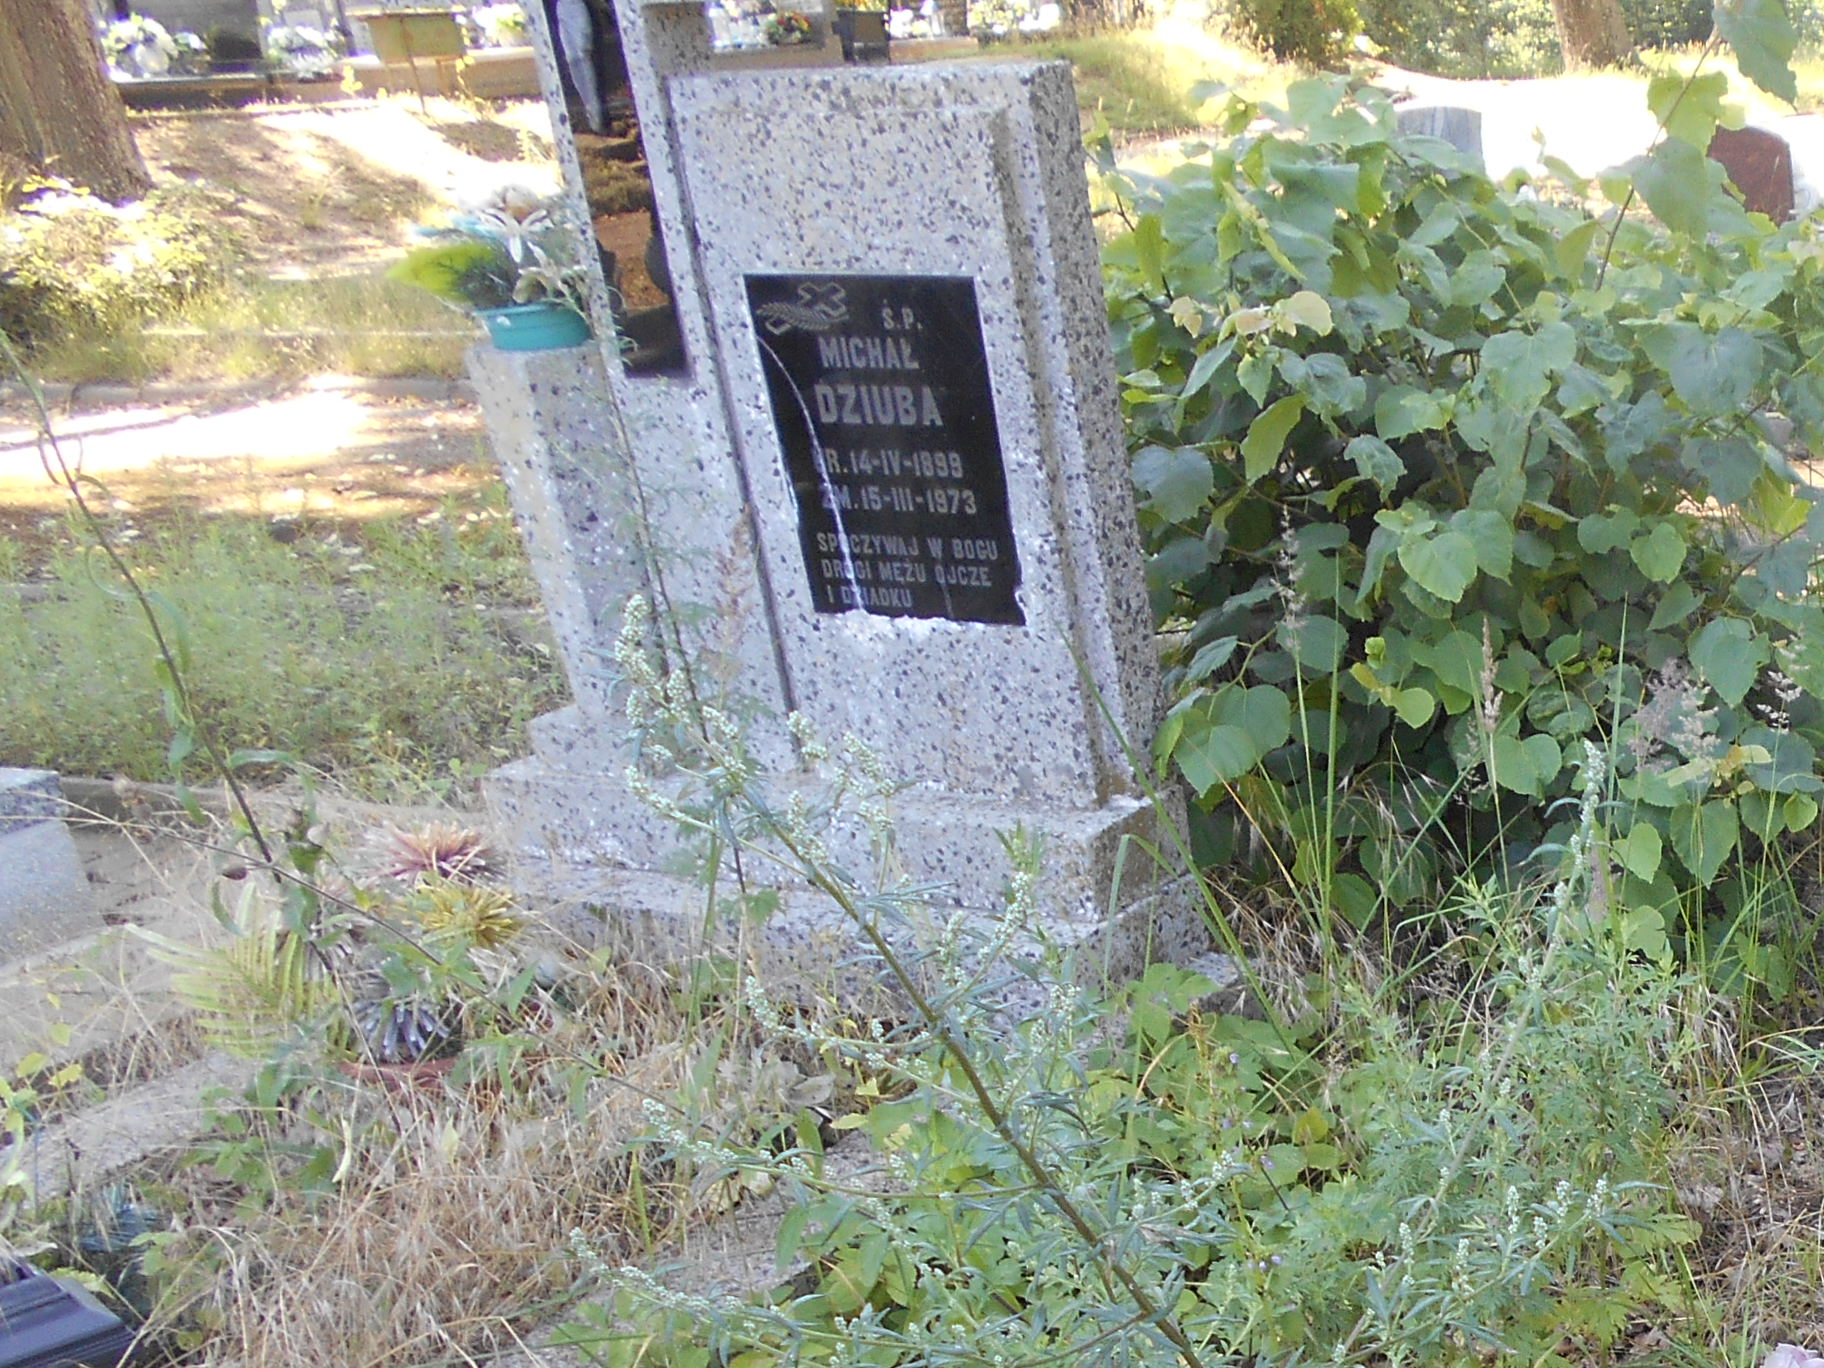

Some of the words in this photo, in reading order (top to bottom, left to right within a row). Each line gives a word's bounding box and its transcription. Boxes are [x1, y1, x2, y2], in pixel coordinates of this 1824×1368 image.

[817, 336, 919, 369] MICHAŁ
[814, 384, 944, 426] DZIUBA
[816, 532, 919, 557] SPCZYWAJ
[927, 537, 942, 559] W
[954, 540, 998, 560] BOGU
[935, 565, 993, 587] OJCZE
[840, 587, 912, 608] DIADKU
